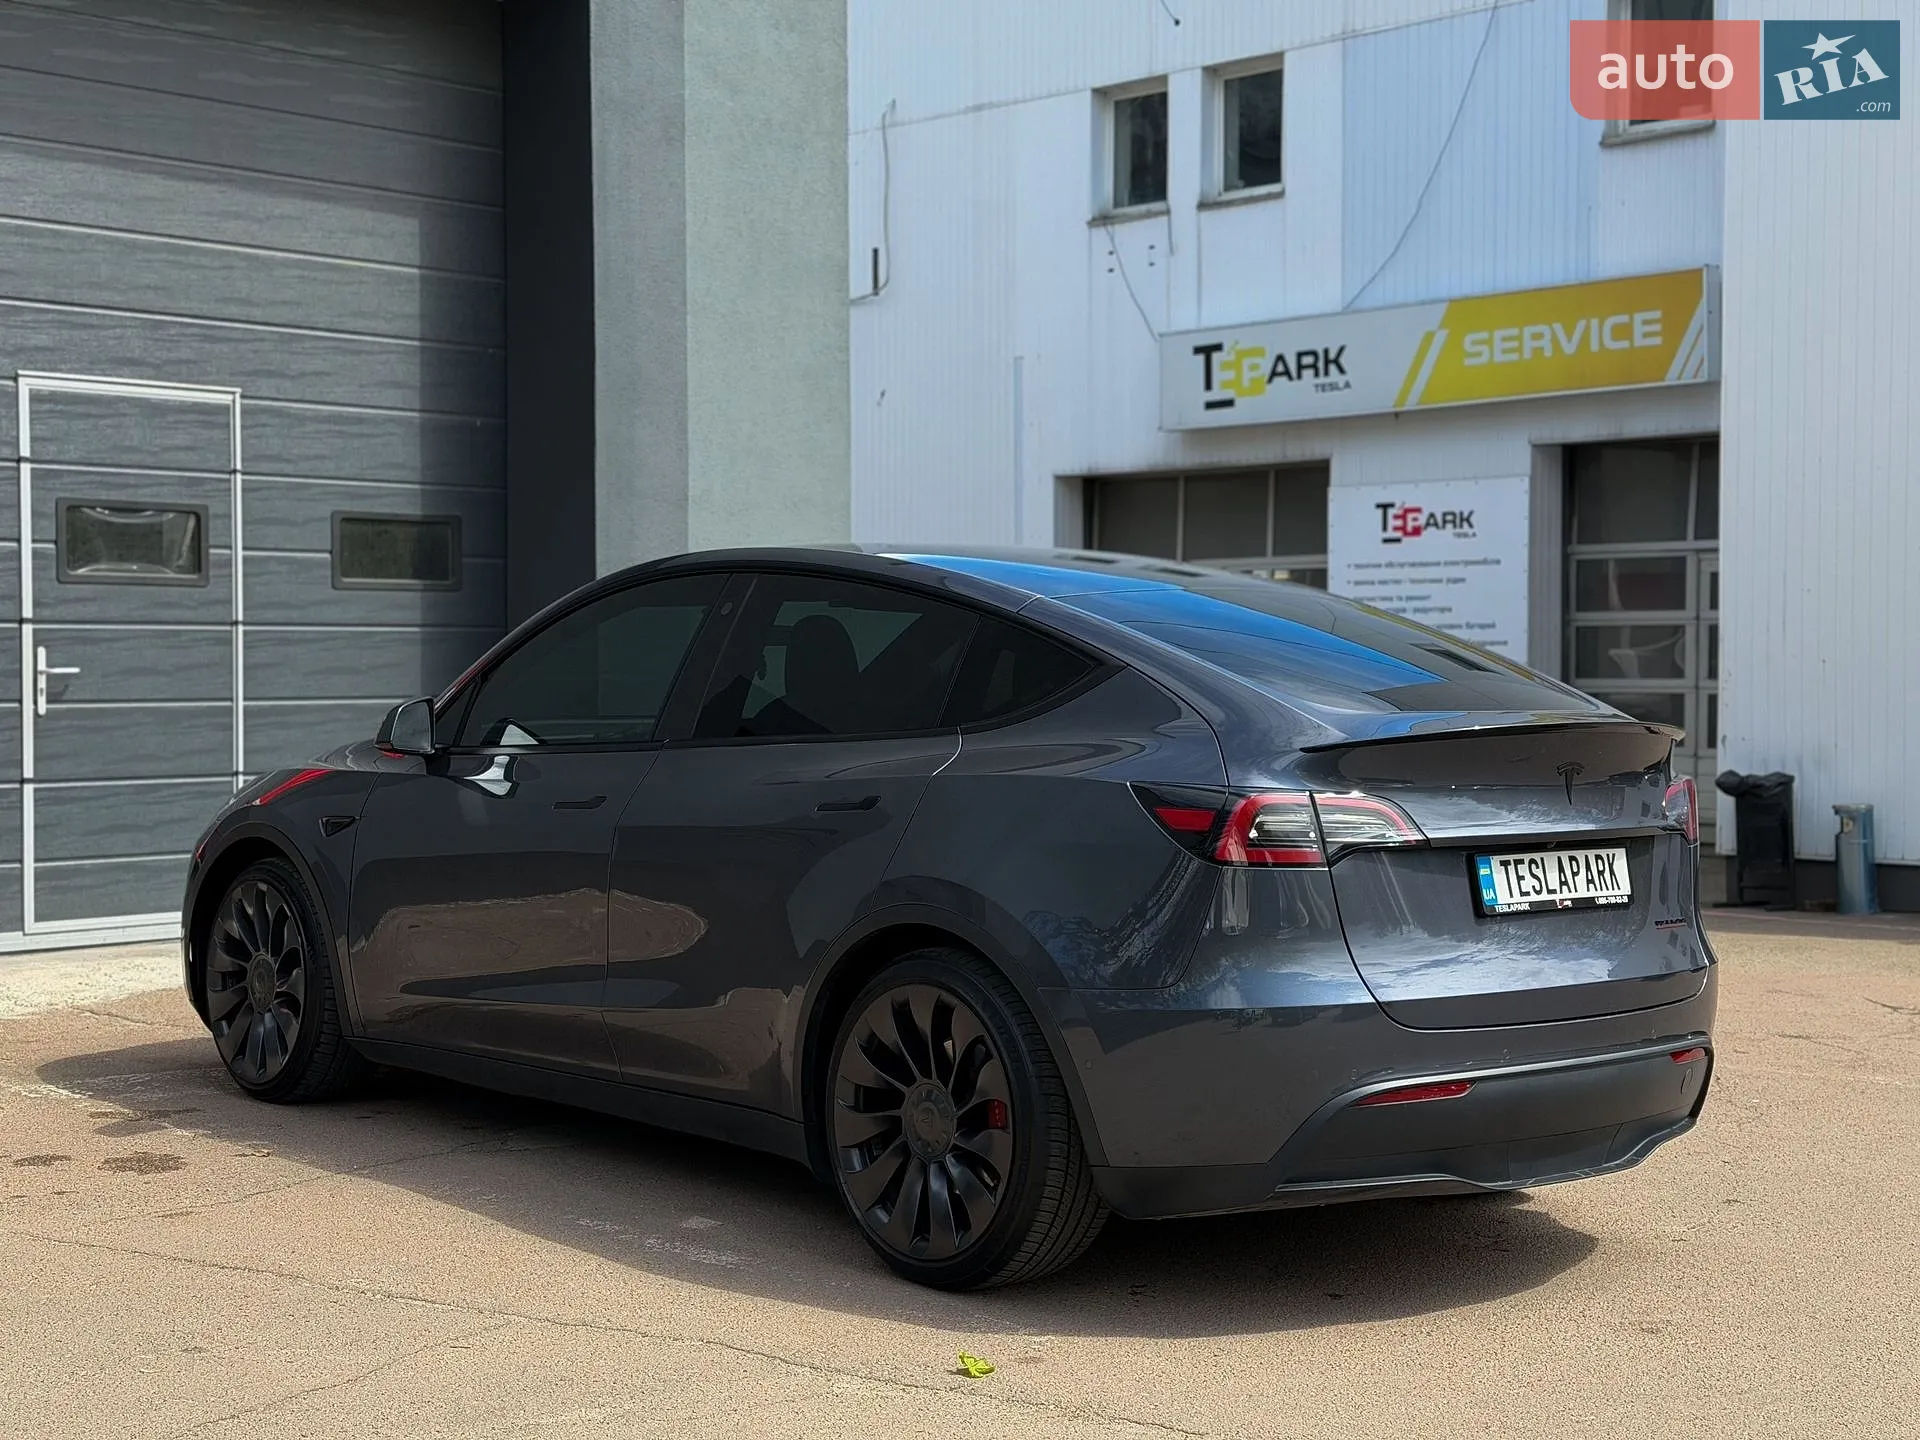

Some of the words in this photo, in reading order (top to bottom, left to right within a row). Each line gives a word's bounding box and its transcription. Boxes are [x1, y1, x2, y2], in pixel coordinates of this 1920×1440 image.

[1462, 310, 1663, 367] SERVICE
[1313, 379, 1353, 394] TESLA
[1499, 853, 1619, 898] TESLAPARK
[1483, 888, 1496, 900] UA
[1494, 903, 1531, 913] TESLAPARK
